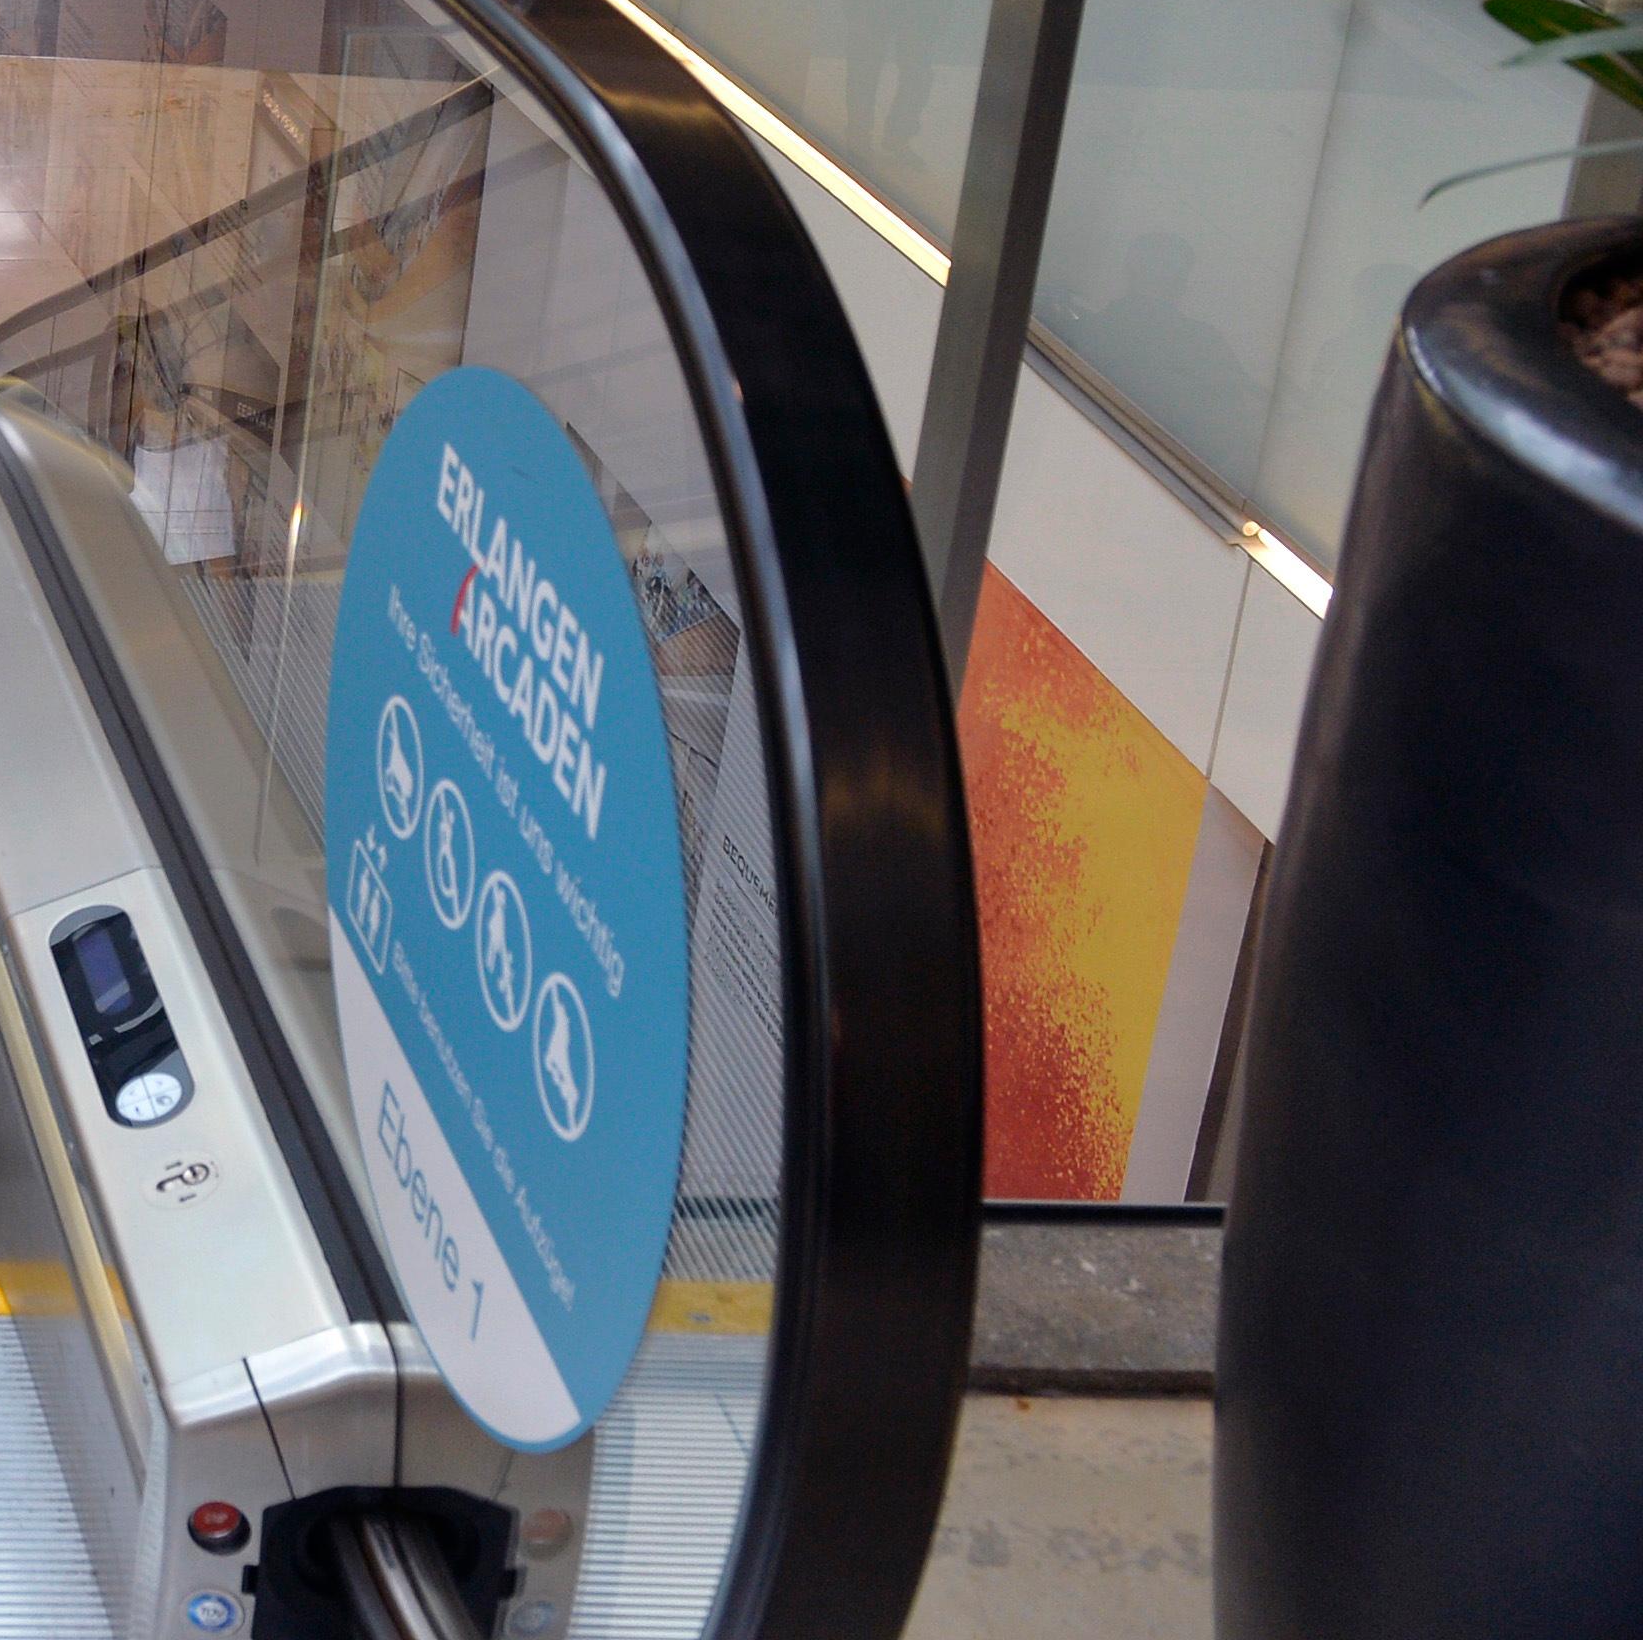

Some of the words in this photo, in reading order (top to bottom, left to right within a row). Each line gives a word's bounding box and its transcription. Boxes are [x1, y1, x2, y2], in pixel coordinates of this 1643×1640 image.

[436, 442, 605, 729] ERLANGEN
[449, 563, 608, 841] ARCADEN
[388, 583, 418, 656] Ihre
[418, 632, 495, 790] Sicherheit
[495, 751, 519, 805] ist
[519, 801, 556, 879] uns
[556, 865, 624, 999] wichtig
[376, 1079, 461, 1291] Ebene
